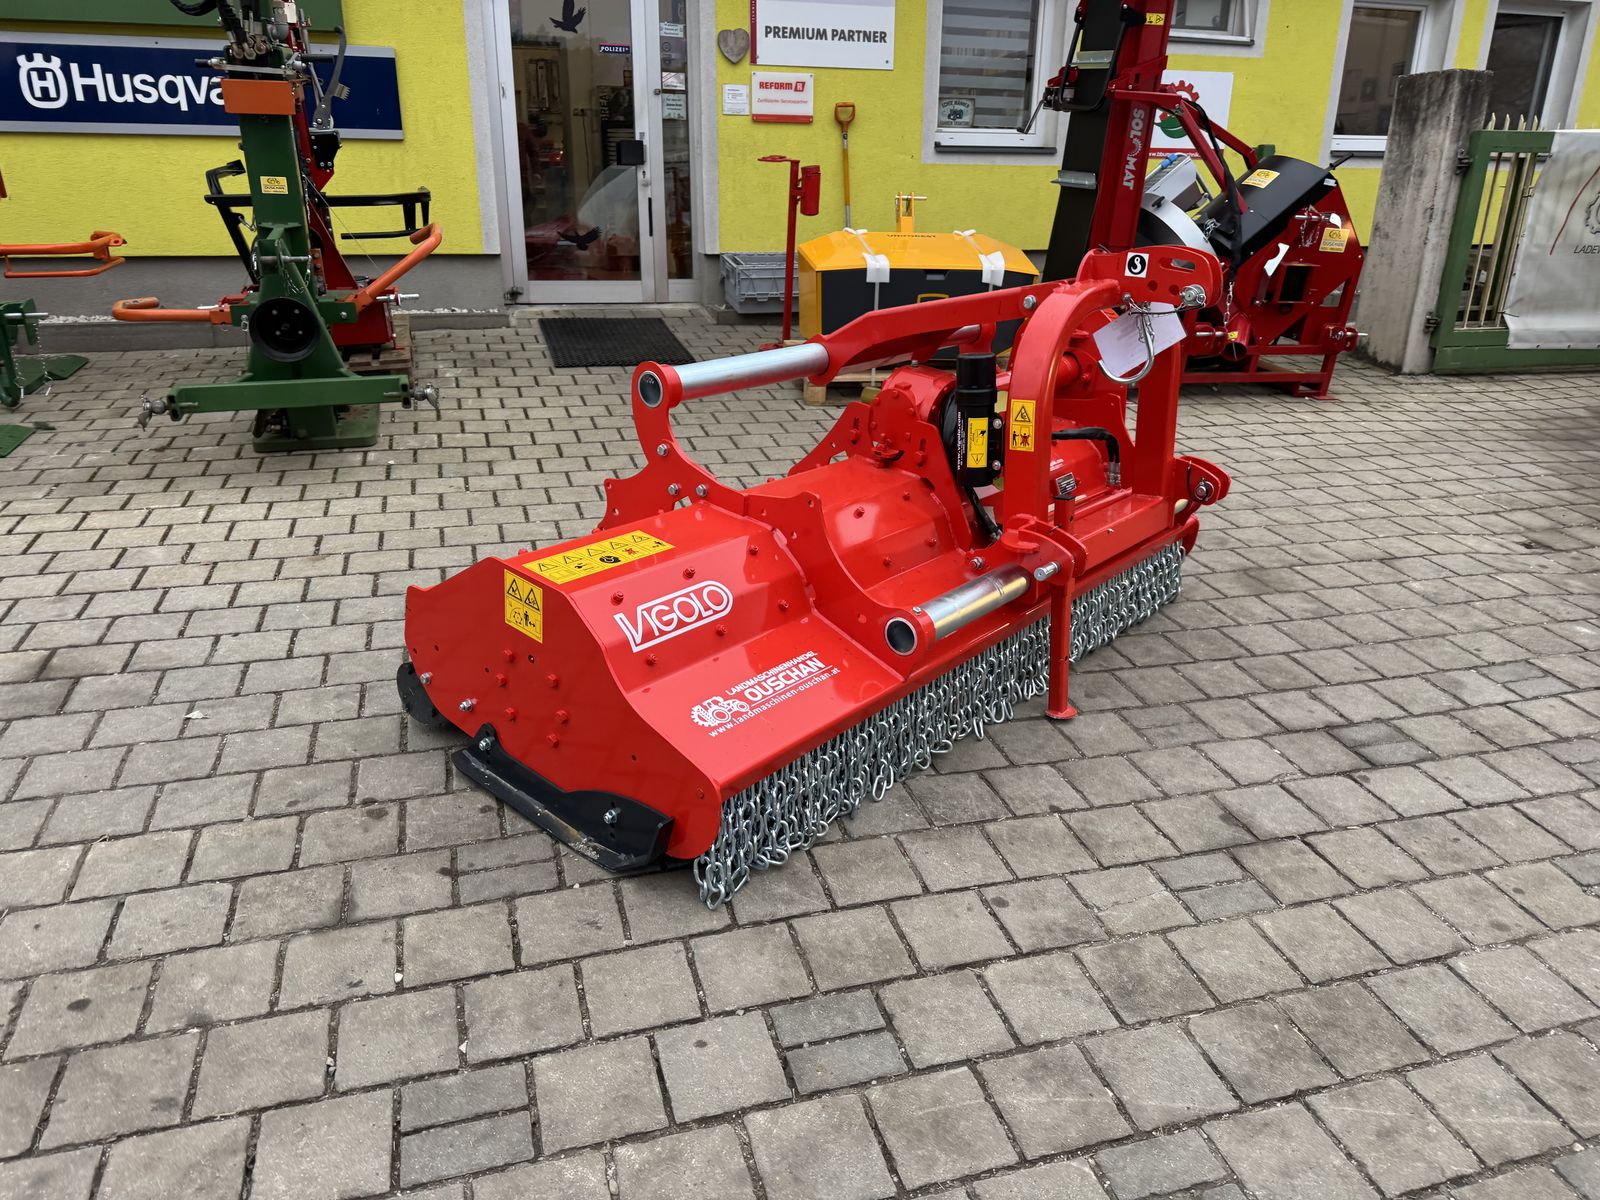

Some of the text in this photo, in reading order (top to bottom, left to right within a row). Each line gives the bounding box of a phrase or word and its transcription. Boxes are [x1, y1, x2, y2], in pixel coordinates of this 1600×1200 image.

[764, 25, 888, 44] PREMIUM PARTNER
[759, 80, 793, 91] REFORM
[613, 580, 734, 654] VIGOLO
[725, 650, 818, 696] LANDMASCHINENHANDEL
[743, 657, 826, 702] OUSCHAN
[708, 667, 841, 738] www.landmaschinen-ouschan.at
